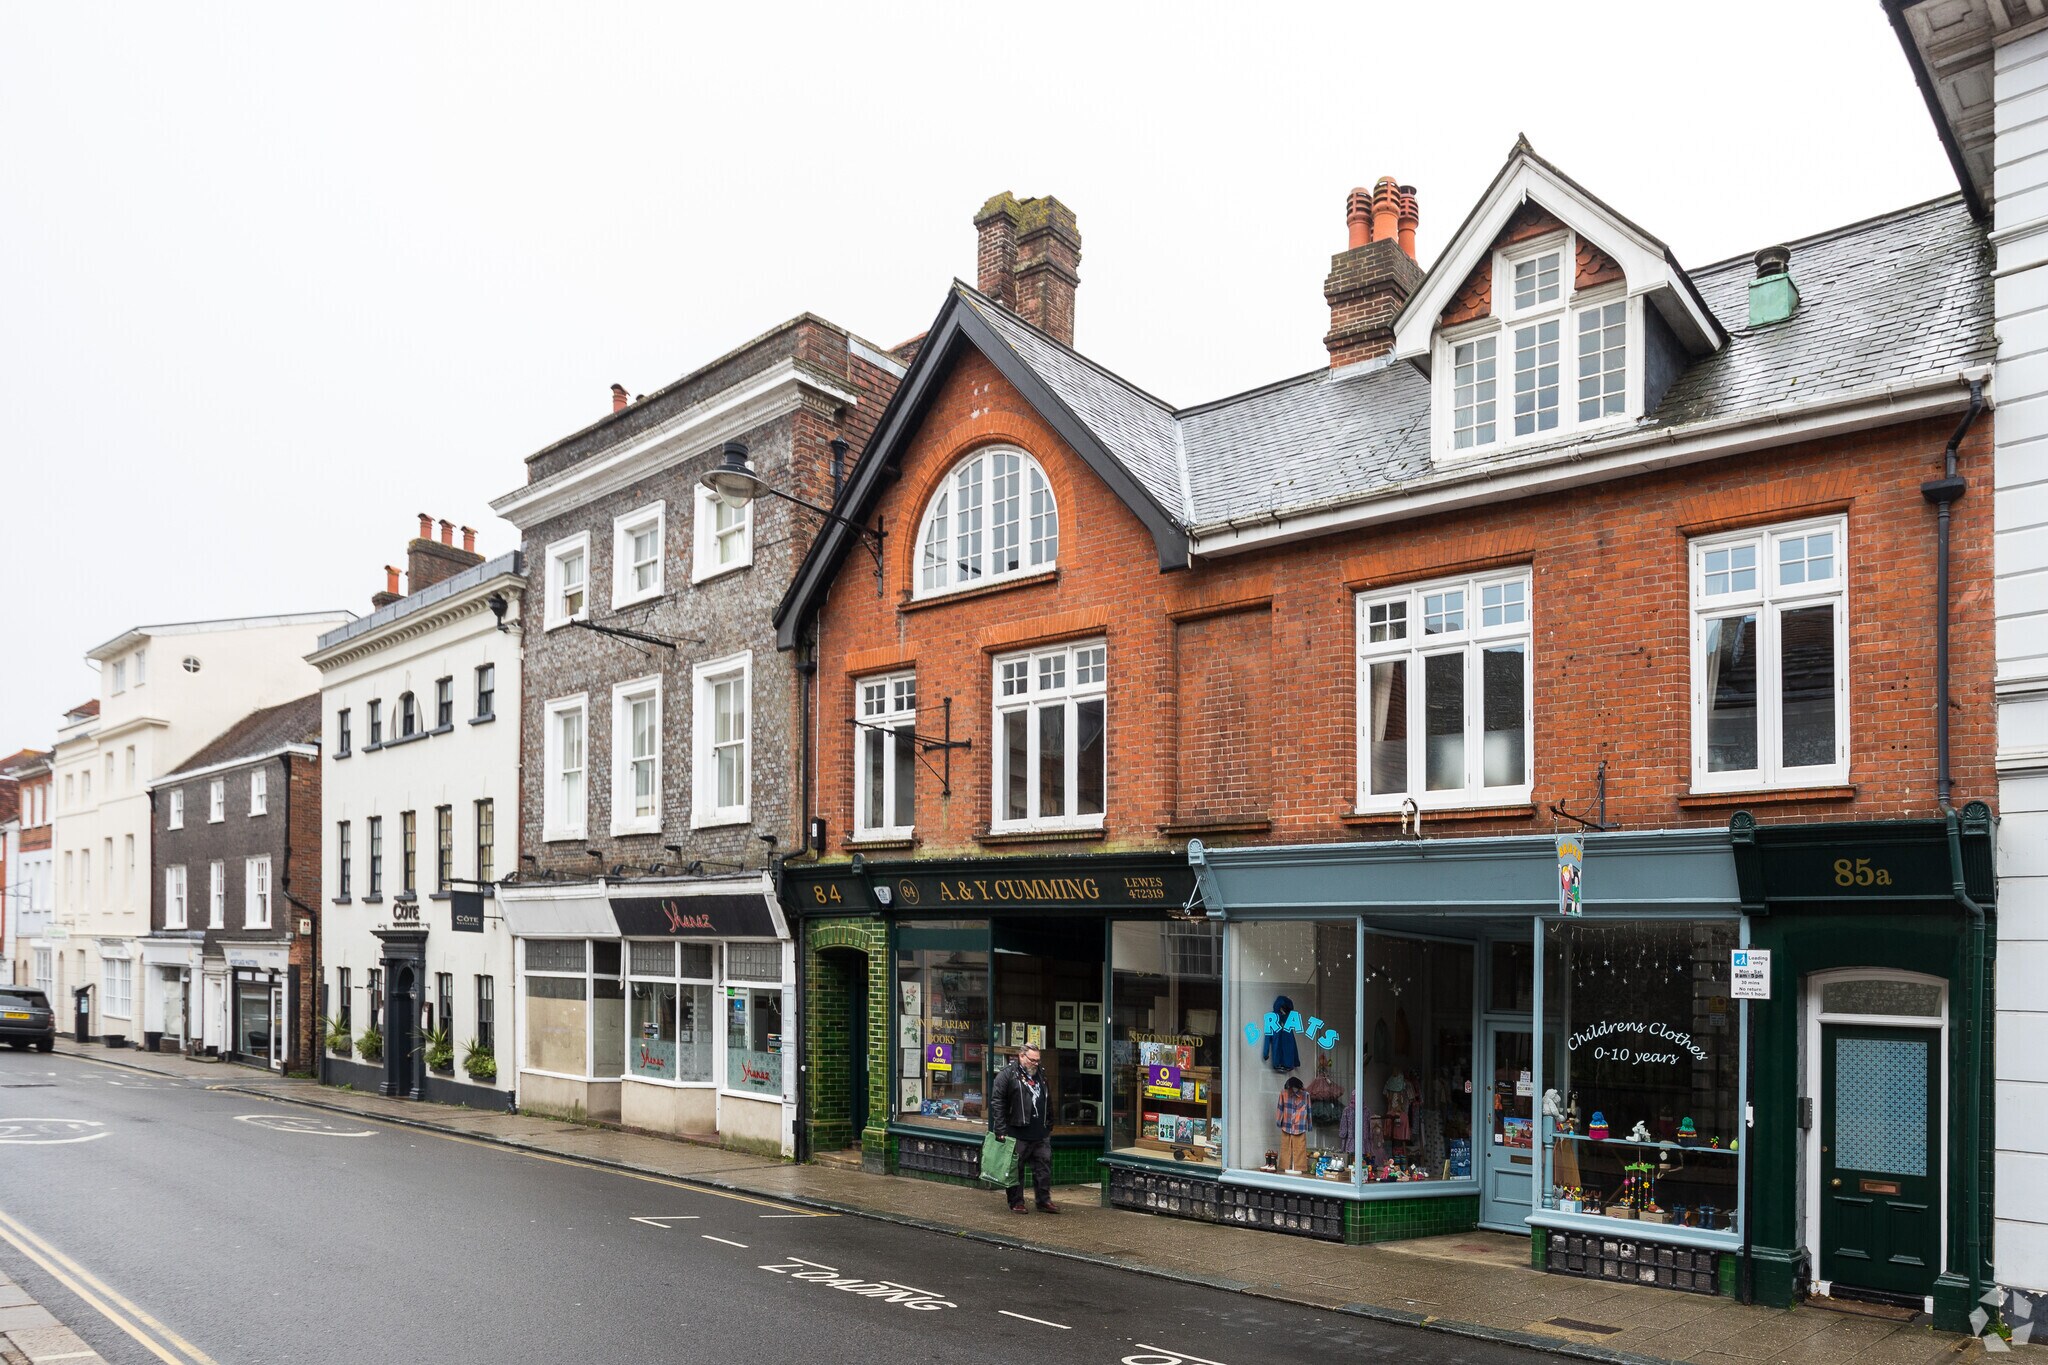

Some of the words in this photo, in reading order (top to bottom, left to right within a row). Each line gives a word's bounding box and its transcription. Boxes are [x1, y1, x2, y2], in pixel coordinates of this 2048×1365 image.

[1558, 842, 1582, 862] BRATS
[1833, 858, 1893, 887] 85a
[994, 878, 1100, 900] CUMMING
[1123, 877, 1163, 888] LEWES
[813, 884, 842, 904] 84
[902, 885, 916, 898] 84
[1129, 889, 1165, 899] 472319
[916, 1018, 970, 1031] ANIQUARIAN
[1244, 1010, 1340, 1050] BRATS
[1130, 1033, 1204, 1048] SECONDHAND
[1567, 1020, 1647, 1051] Childrens
[1649, 1022, 1708, 1061] Clothes
[1632, 1051, 1680, 1066] years
[1155, 1079, 1173, 1088] Oakley
[757, 1264, 958, 1311] LOADING
